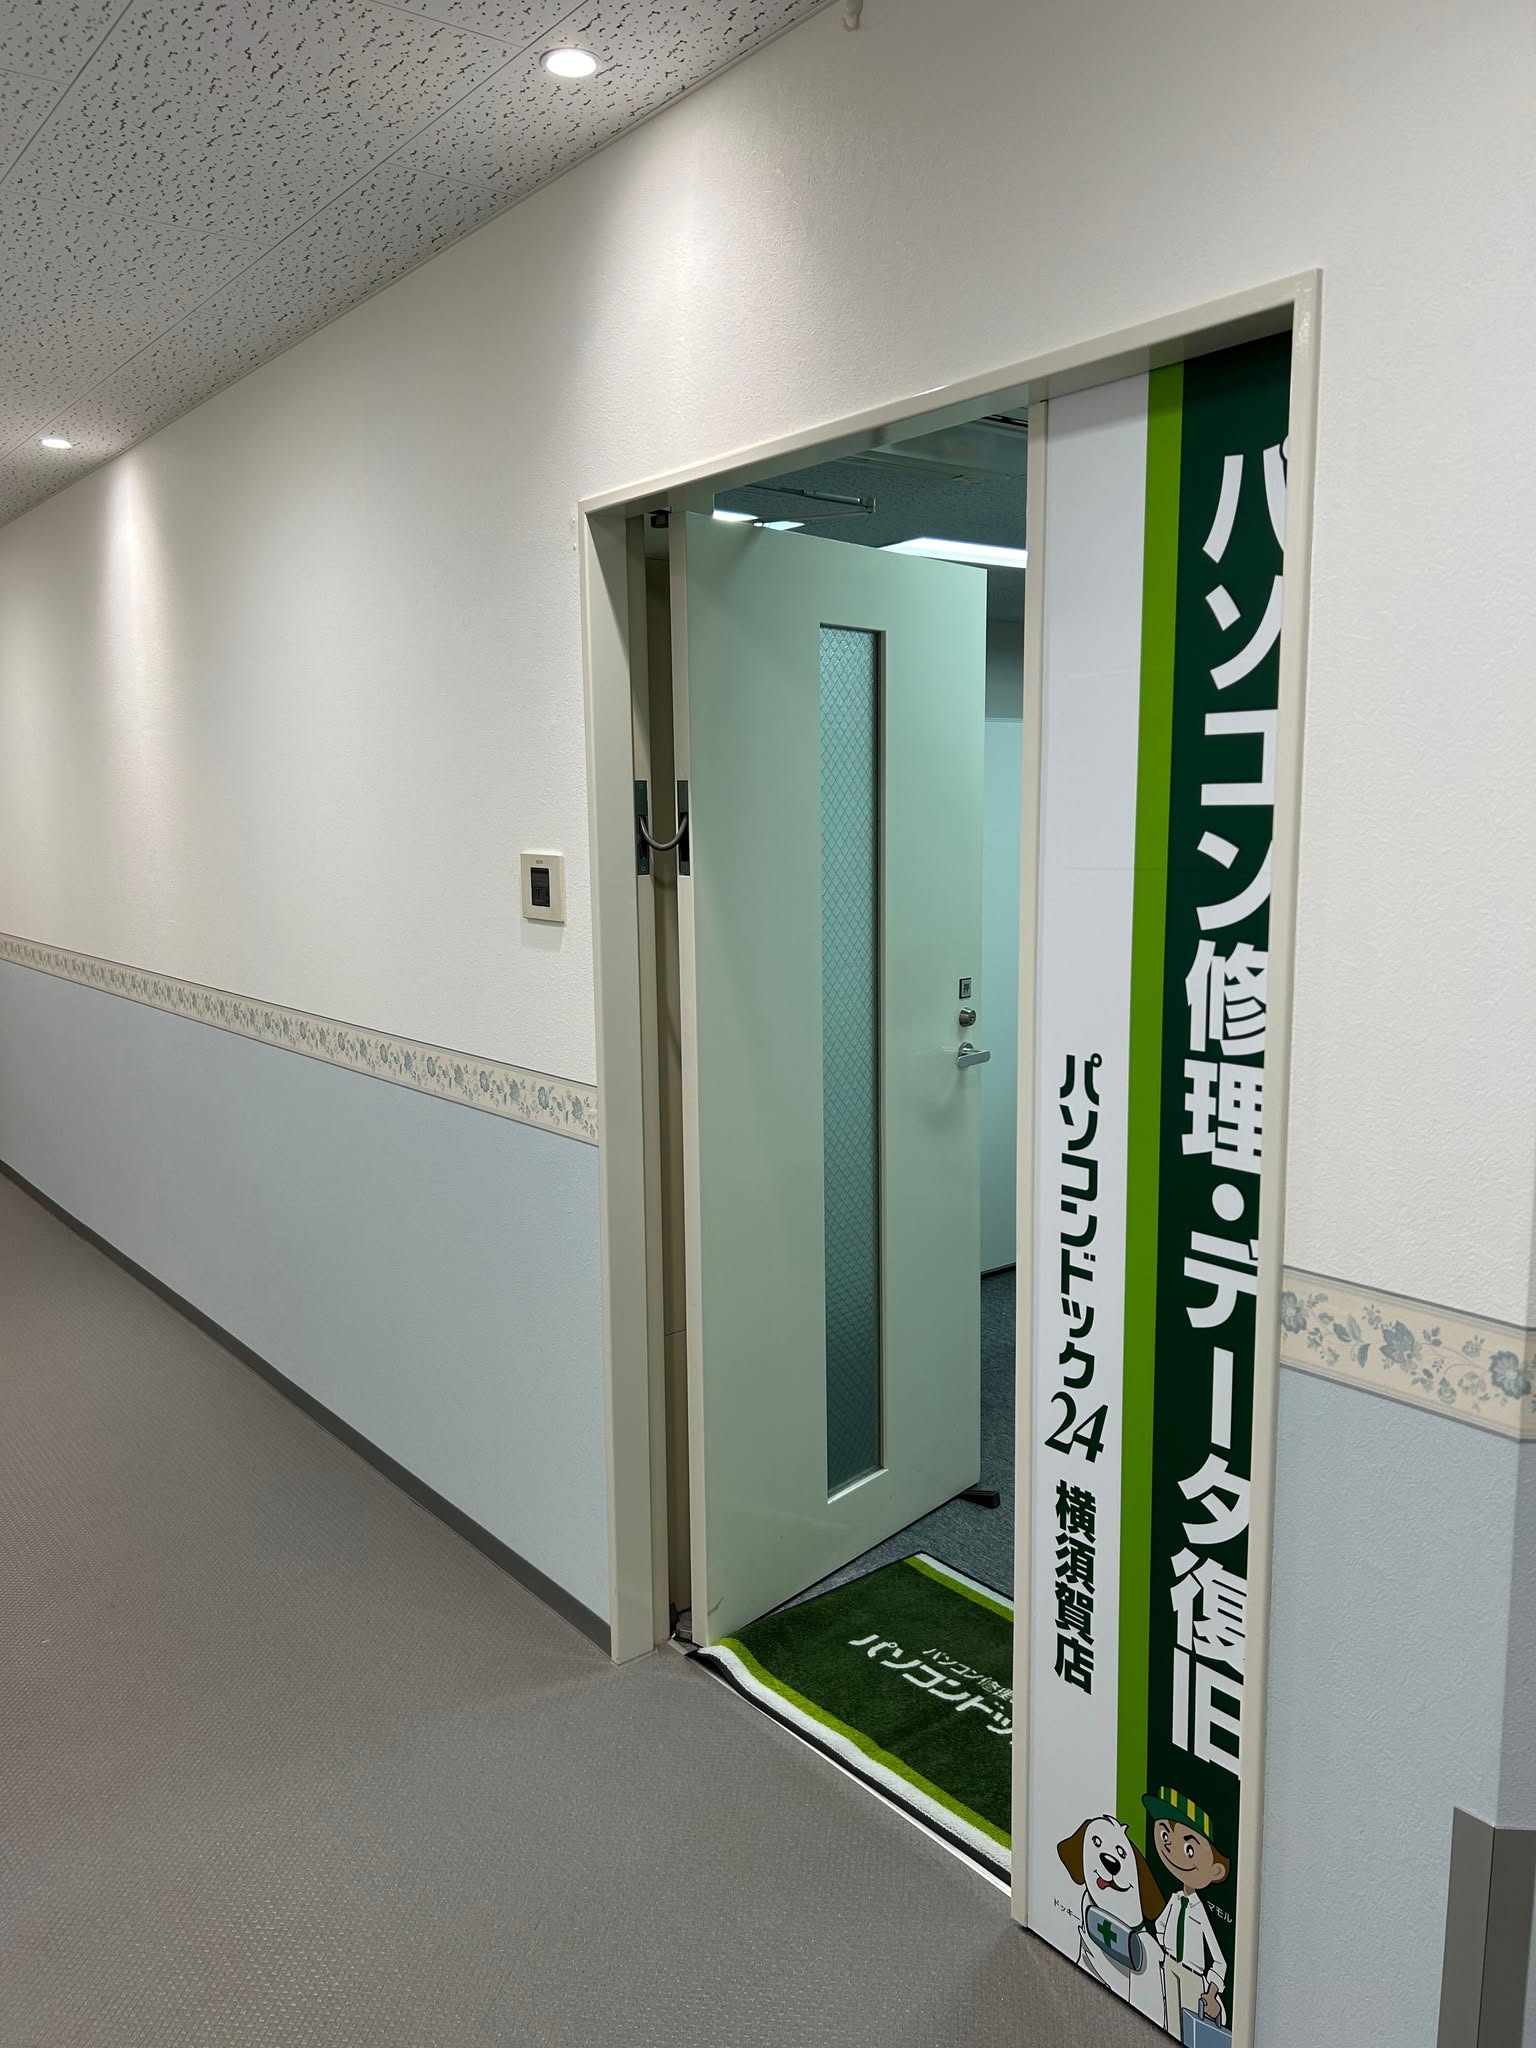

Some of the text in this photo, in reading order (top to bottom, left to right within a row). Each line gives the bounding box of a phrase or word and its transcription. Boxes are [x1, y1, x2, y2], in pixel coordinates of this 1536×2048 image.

[1169, 436, 1290, 1781] パソコン修理・データ復旧
[1054, 1479, 1096, 1695] 横須賀店
[847, 1633, 1013, 1745] パソコンドッ
[1053, 1898, 1081, 1921] ドッキー
[1206, 1899, 1233, 1923] マモル
